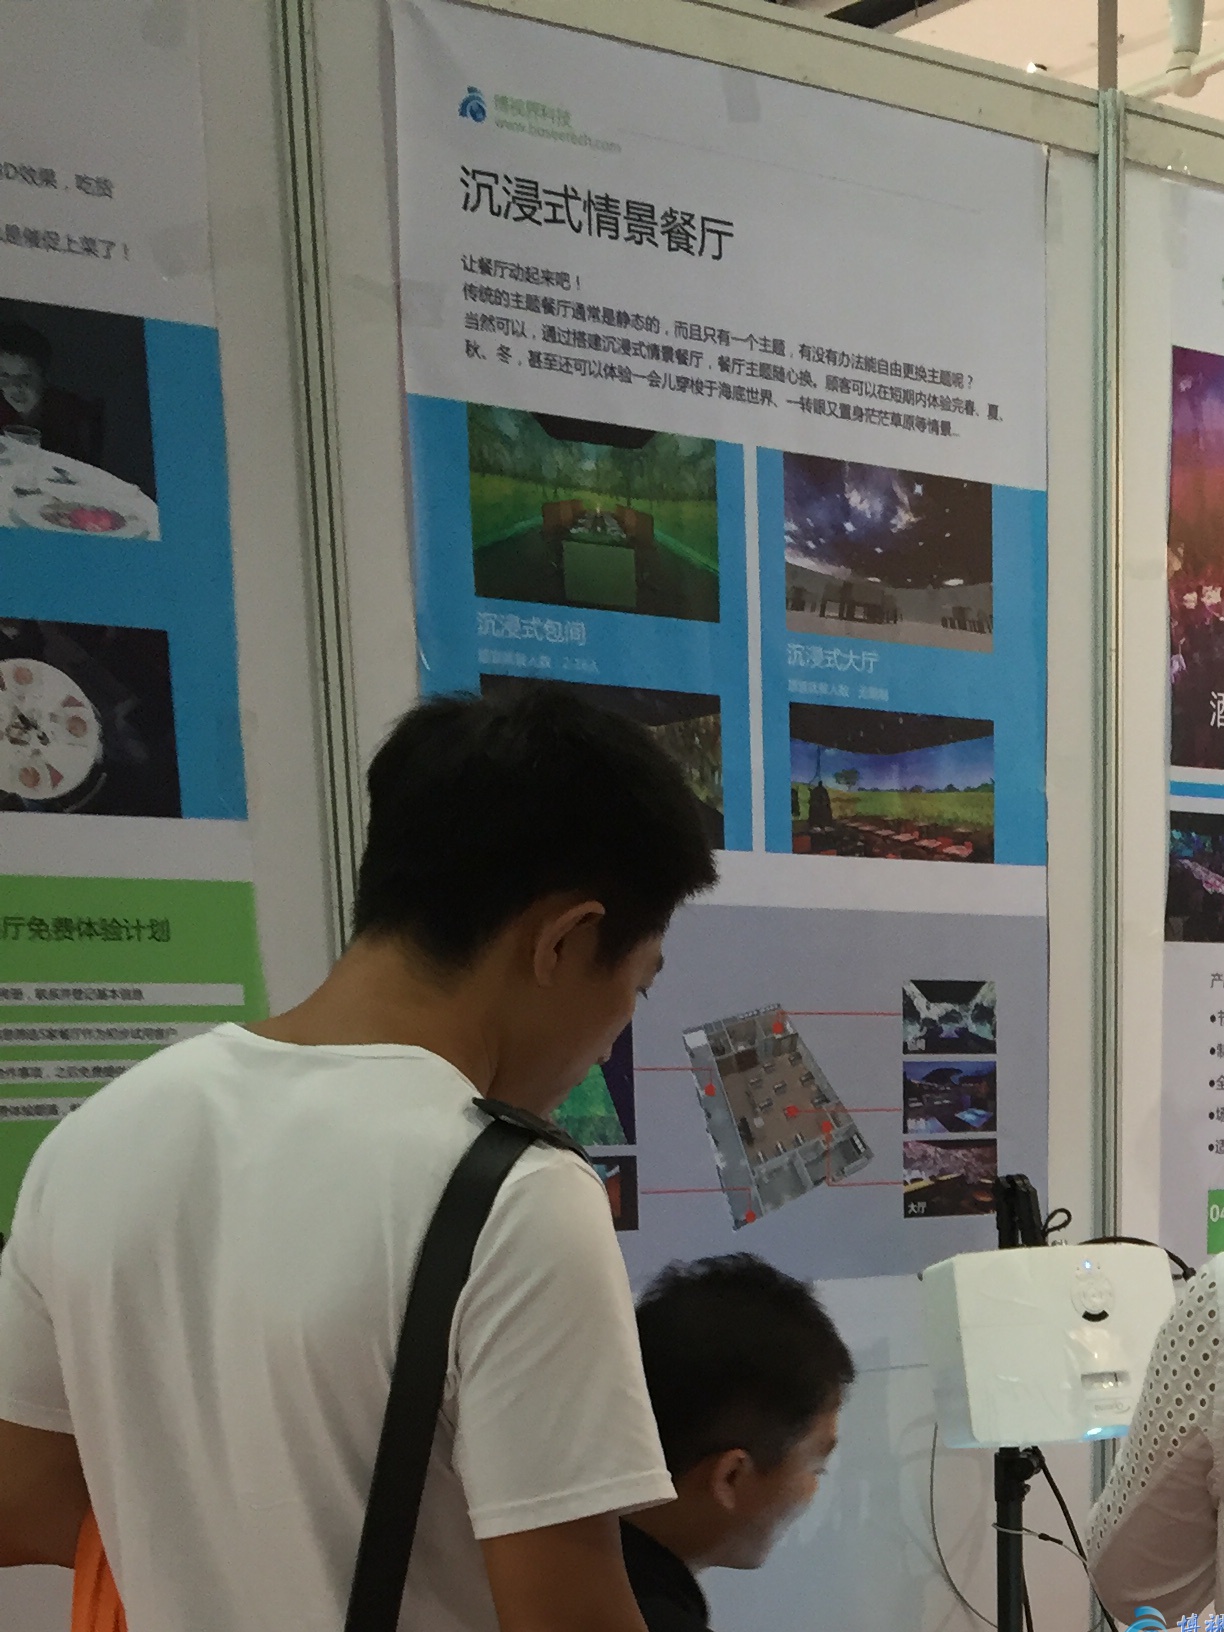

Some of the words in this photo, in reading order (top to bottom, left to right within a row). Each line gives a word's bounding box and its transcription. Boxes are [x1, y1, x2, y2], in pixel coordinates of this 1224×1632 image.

[459, 165, 735, 262] 沉浸式情景餐厅
[460, 254, 582, 292] 让餐厅动起来吧！
[476, 611, 586, 647] 沉浸式包间
[786, 642, 880, 674] 沉浸式大厅
